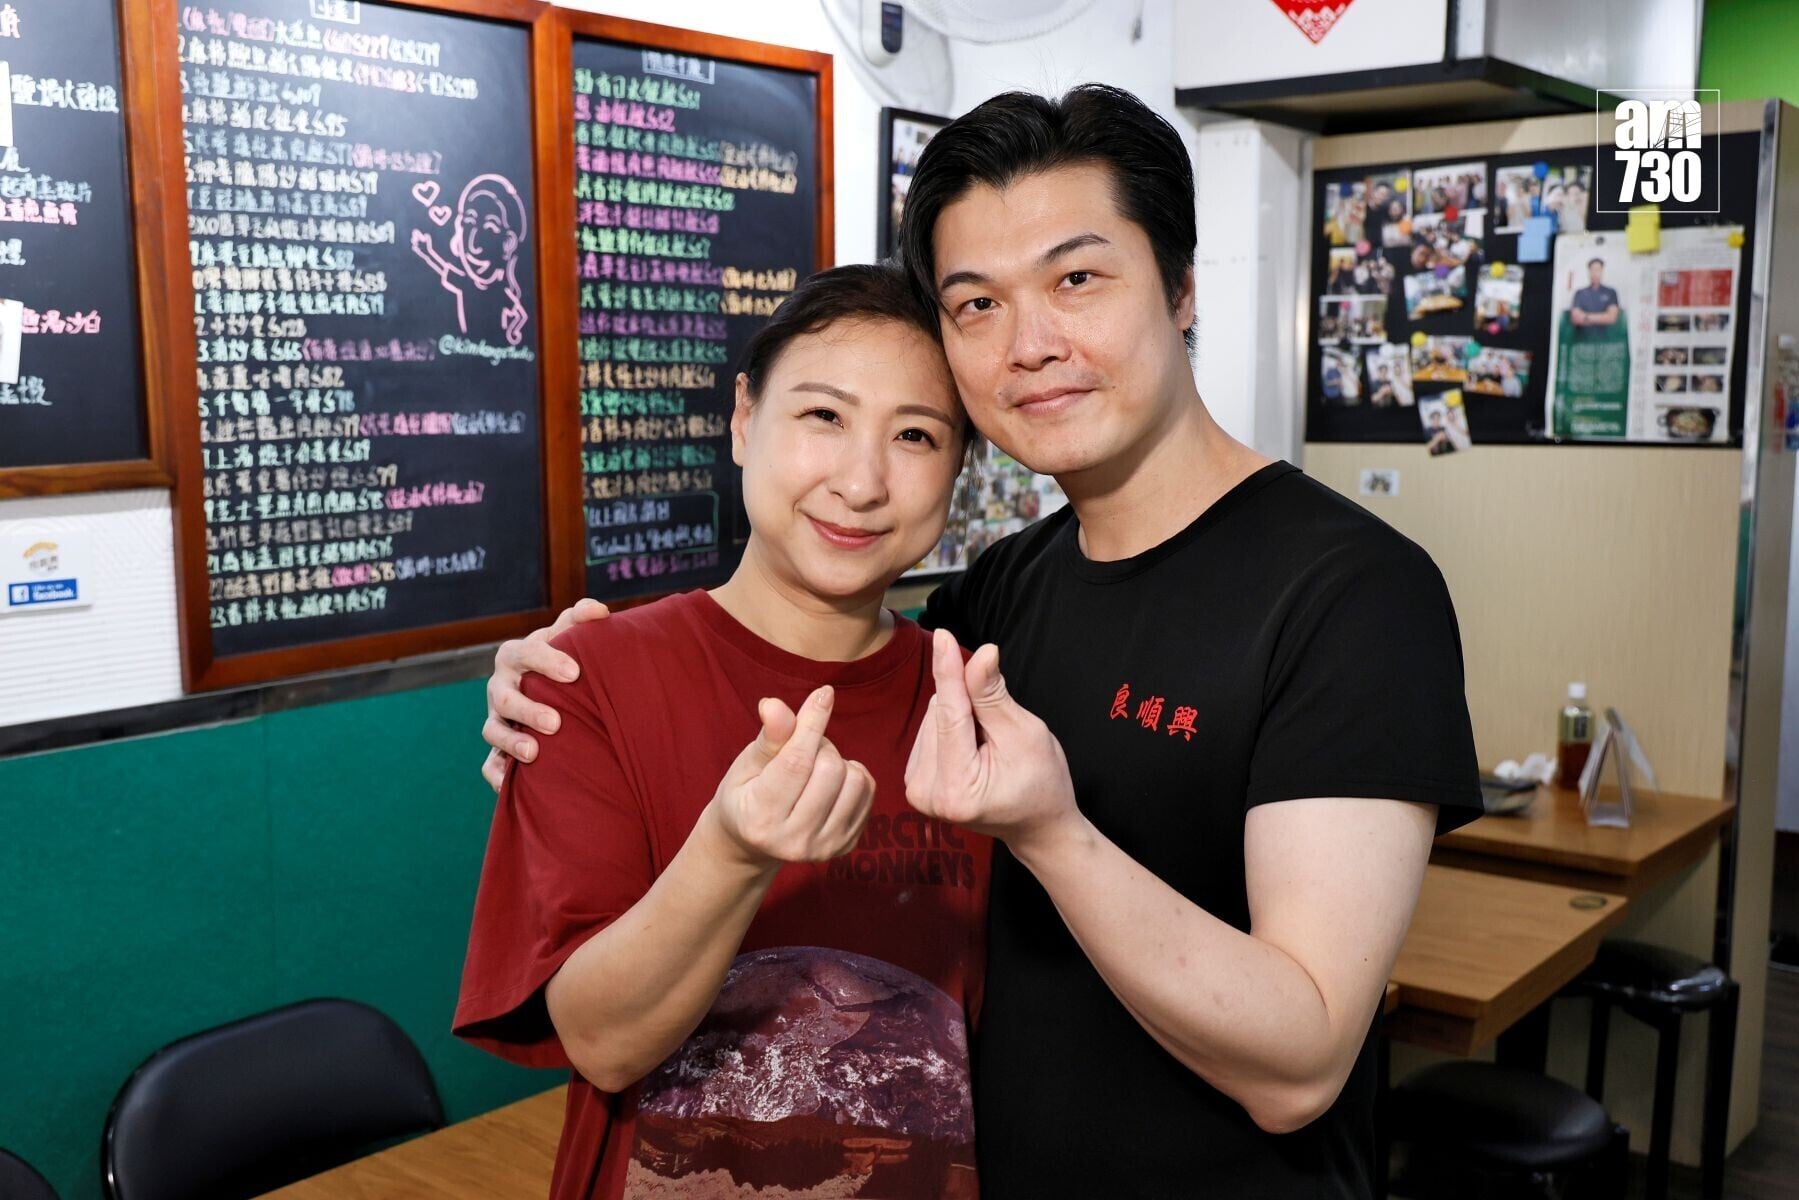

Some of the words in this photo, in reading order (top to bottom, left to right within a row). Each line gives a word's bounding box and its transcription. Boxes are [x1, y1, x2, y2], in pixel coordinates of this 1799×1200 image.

[1110, 683, 1198, 741] 良順興
[827, 850, 977, 889] MONKEYS
